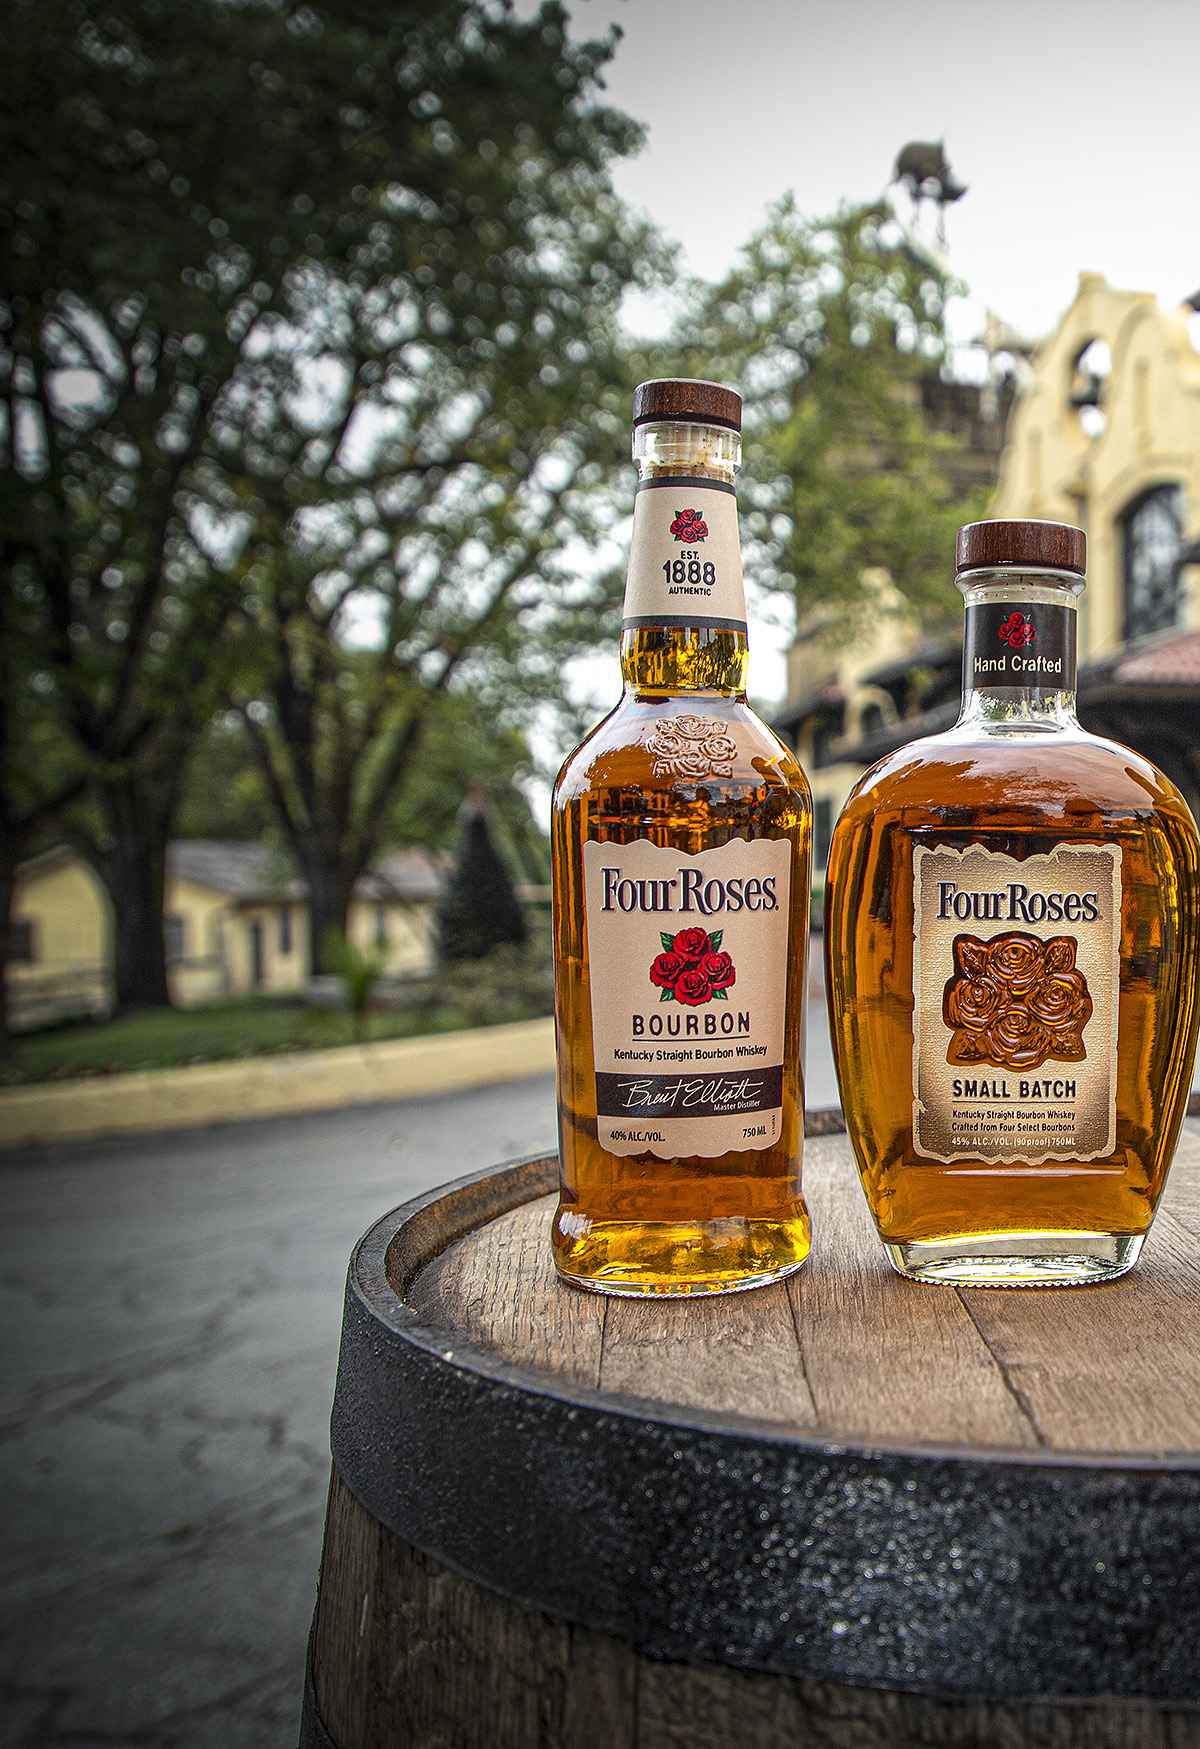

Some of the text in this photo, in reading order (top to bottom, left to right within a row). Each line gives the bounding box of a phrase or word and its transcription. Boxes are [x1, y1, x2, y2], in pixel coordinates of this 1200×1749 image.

[681, 551, 700, 560] EST.
[663, 560, 716, 586] 1888
[669, 587, 711, 596] AUTHENTIC
[974, 655, 1062, 673] Hand Crafted
[600, 867, 677, 913] Four
[936, 882, 1006, 921] Four
[632, 1012, 750, 1037] BOURBON
[614, 1045, 767, 1062] Kentucky Straight Bourbon Whiskey
[953, 1080, 1076, 1098] SMALL BATCH
[714, 1100, 760, 1111] Master Distiller
[953, 1110, 1076, 1121] Kentucky Straight Bourbon Whiskey
[952, 1122, 1076, 1132] Crafted from Four Select Bourbons
[611, 1131, 627, 1141] 40%
[952, 1138, 970, 1146] 45%
